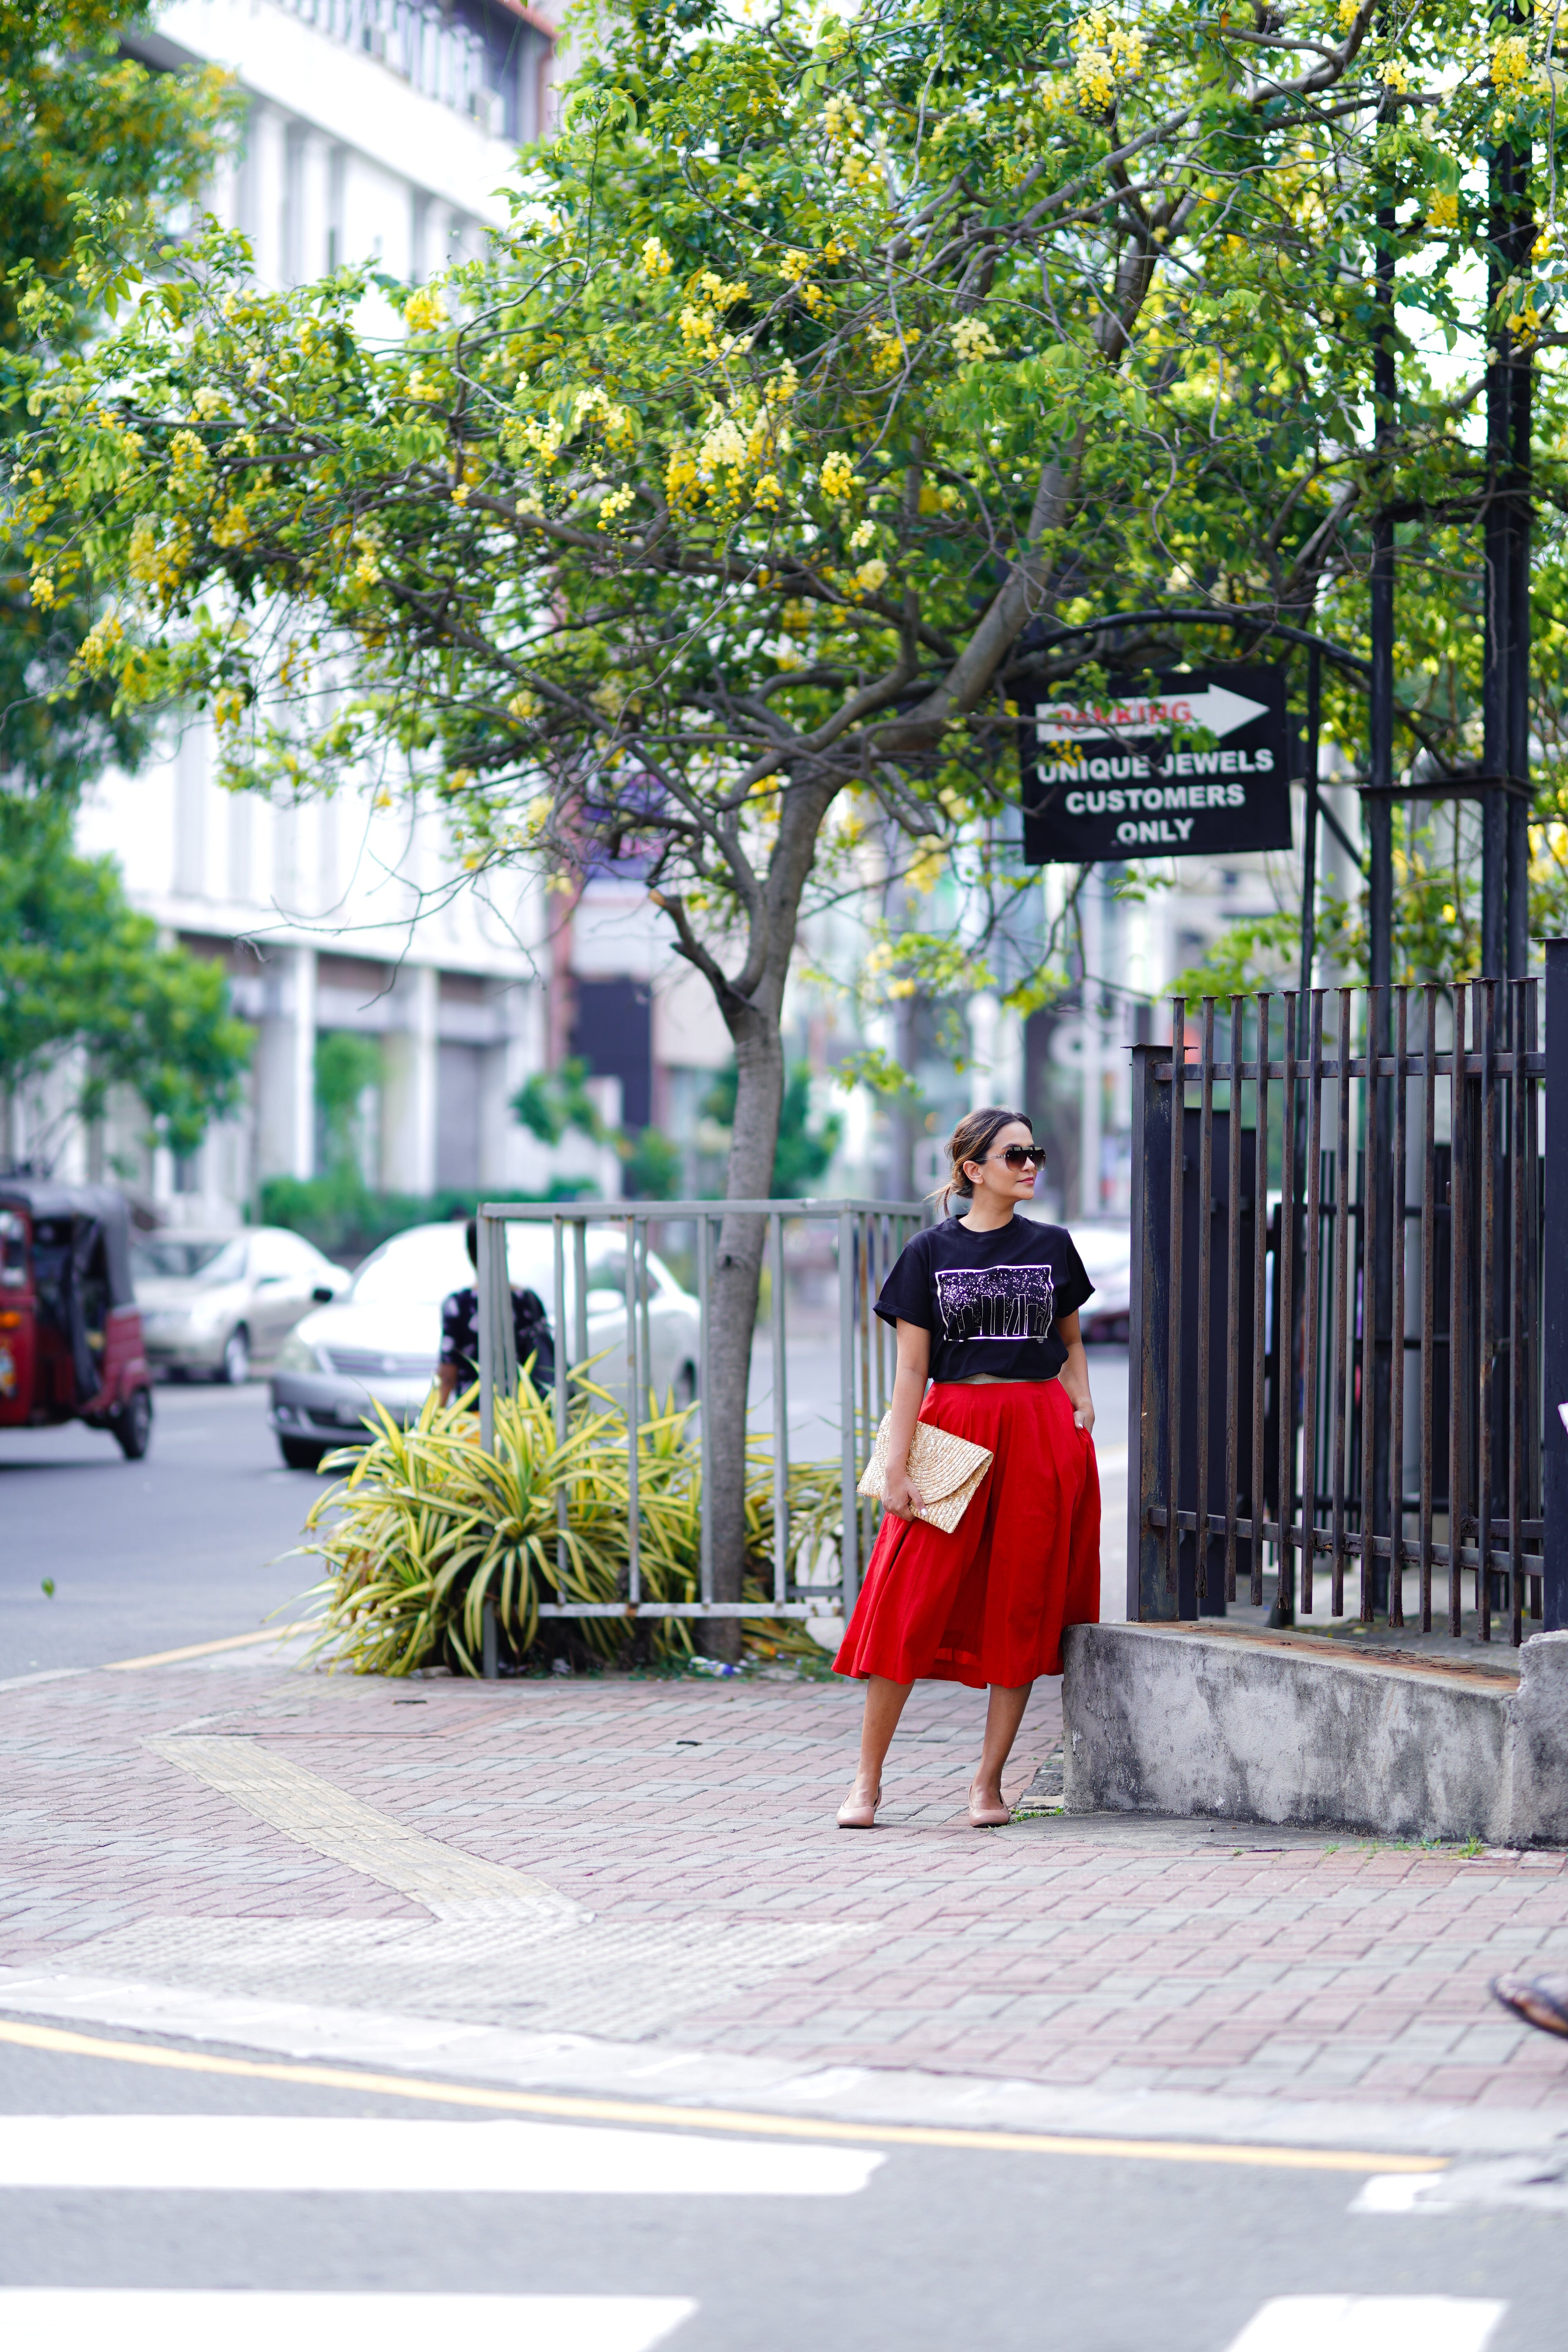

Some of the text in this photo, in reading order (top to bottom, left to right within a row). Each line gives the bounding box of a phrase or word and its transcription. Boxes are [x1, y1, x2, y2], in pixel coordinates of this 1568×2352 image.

[1038, 749, 1274, 784] UNIQUE JEWELS
[1066, 784, 1245, 814] CUSTOMERS
[1116, 818, 1193, 844] ONLY
